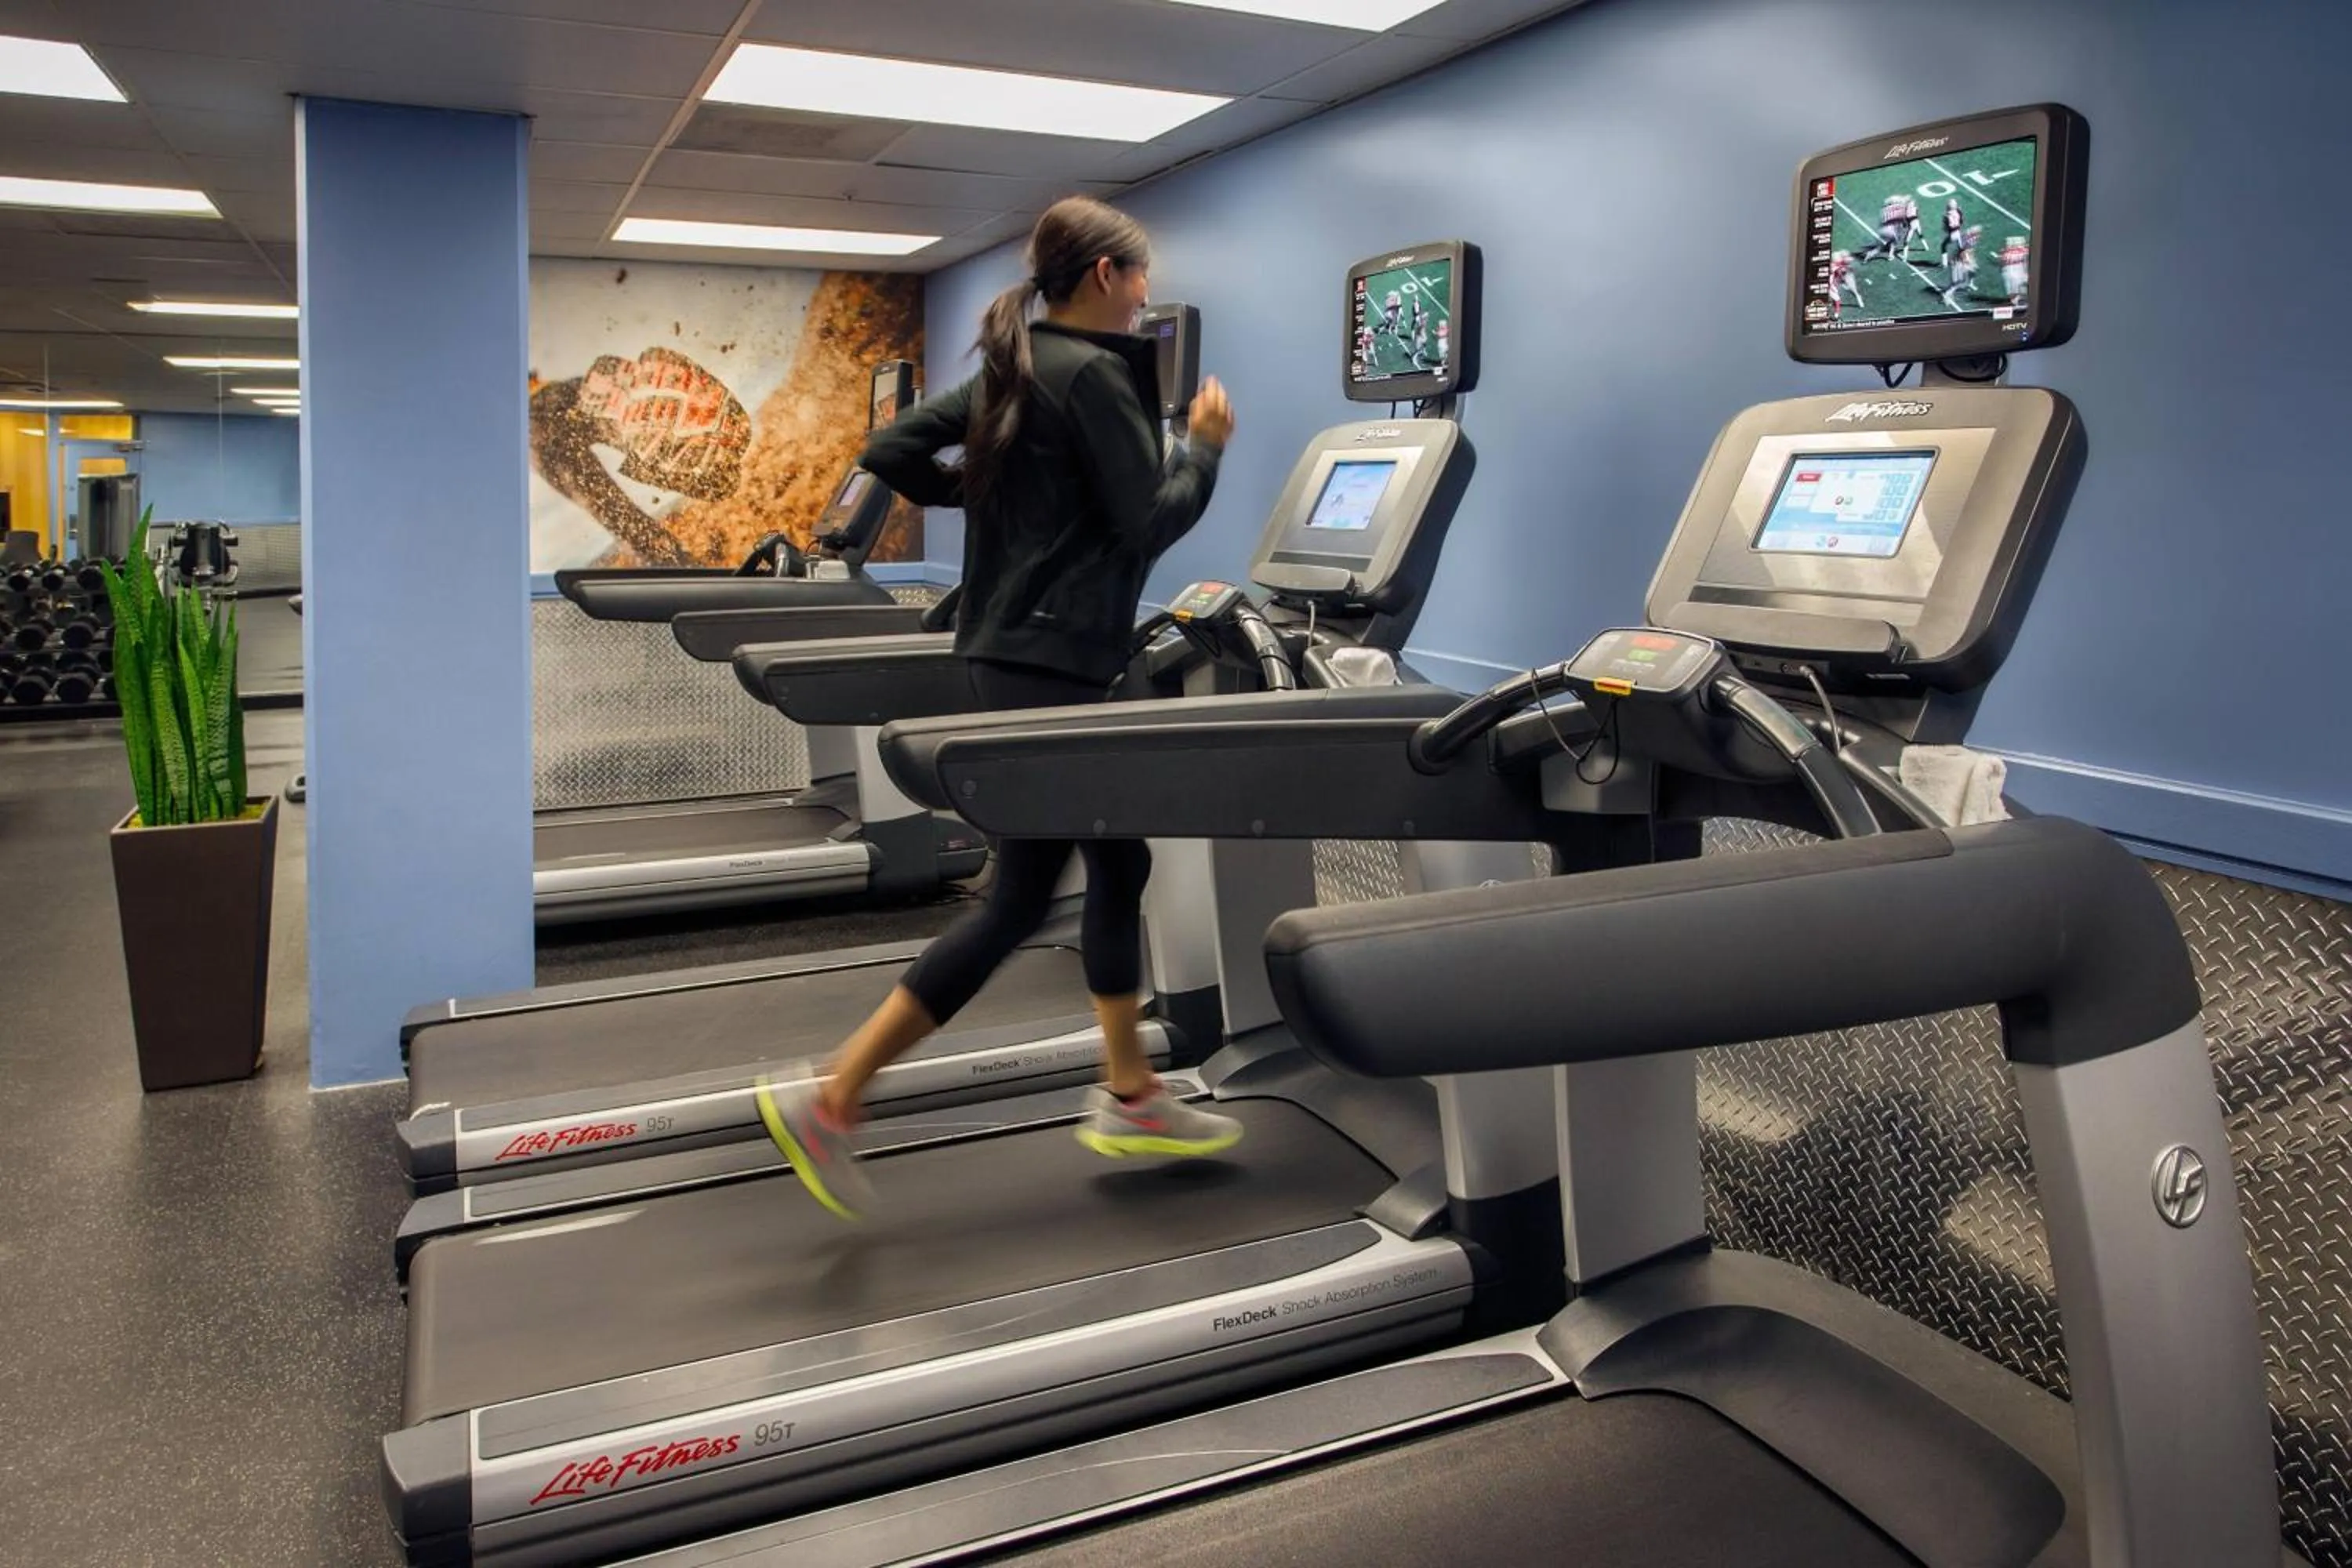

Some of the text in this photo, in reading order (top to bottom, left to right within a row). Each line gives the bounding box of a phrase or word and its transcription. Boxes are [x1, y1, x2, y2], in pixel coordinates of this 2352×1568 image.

[1213, 1305, 1278, 1332] FlexDeck
[1282, 1294, 1321, 1316] Shock
[753, 1420, 796, 1446] 95T
